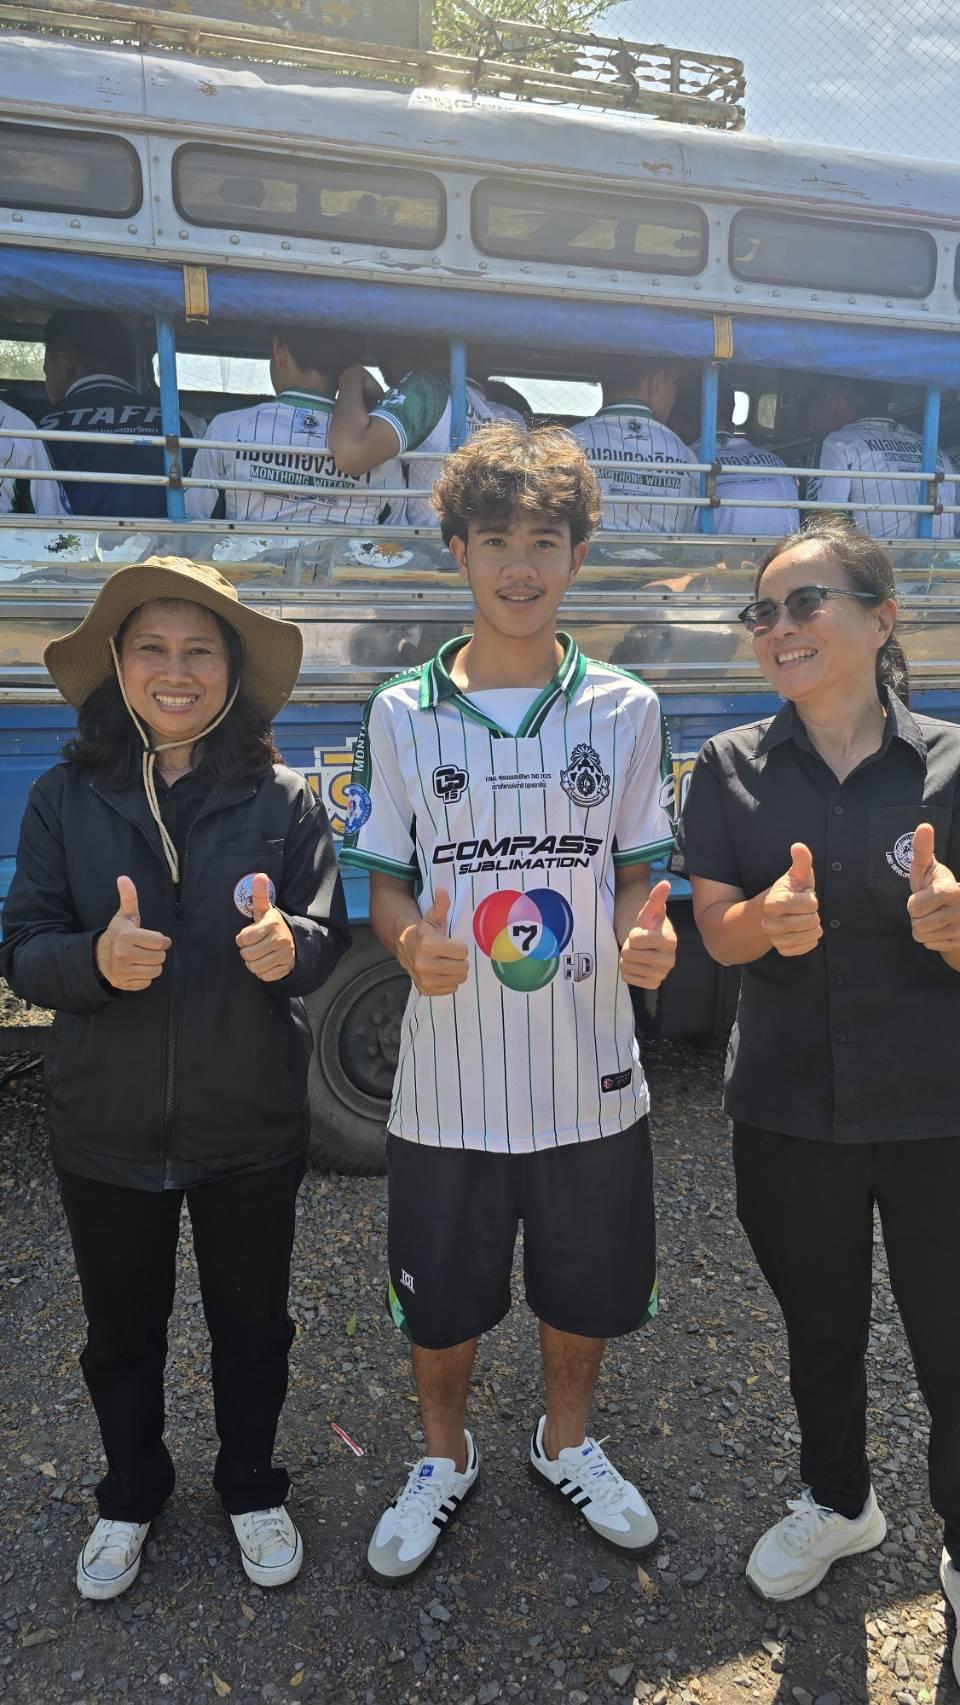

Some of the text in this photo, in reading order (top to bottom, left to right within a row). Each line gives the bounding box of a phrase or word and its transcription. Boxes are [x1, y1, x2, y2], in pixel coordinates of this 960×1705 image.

[40, 405, 161, 430] STAFF
[250, 466, 309, 487] MONTHONG
[432, 835, 603, 864] COMPASS
[458, 857, 590, 875] SUBLIMATION
[512, 925, 538, 951] 7
[563, 952, 594, 982] HD
